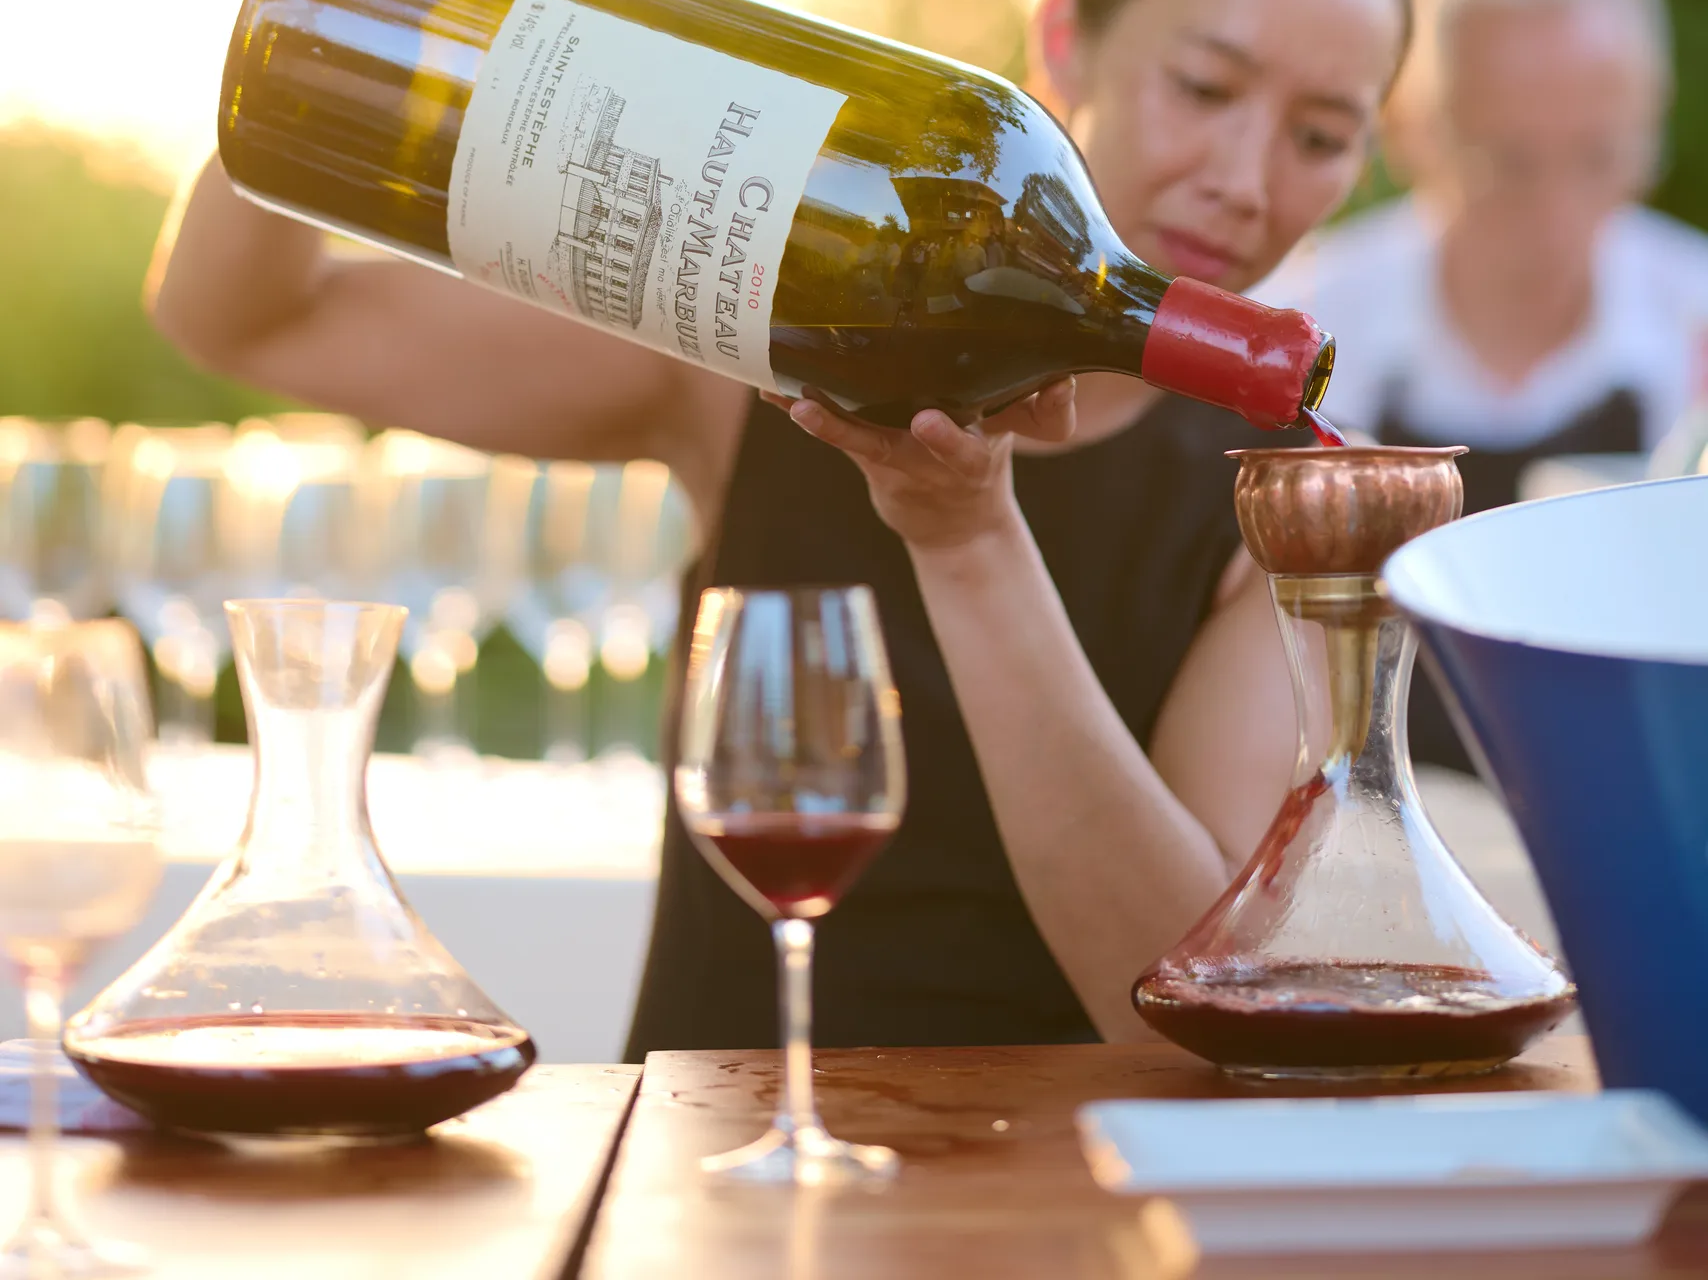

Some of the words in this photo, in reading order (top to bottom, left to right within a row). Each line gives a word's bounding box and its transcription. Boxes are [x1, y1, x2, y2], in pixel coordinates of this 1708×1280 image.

[529, 38, 546, 67] GRAND
[545, 13, 577, 64] APPELLATION
[518, 83, 526, 97] DE
[522, 69, 532, 83] VIN
[501, 98, 520, 145] BORDEAUX
[522, 36, 580, 168] SAINT-ESTÈPHE
[715, 176, 775, 360] CHATEAU
[748, 263, 765, 310] 2010
